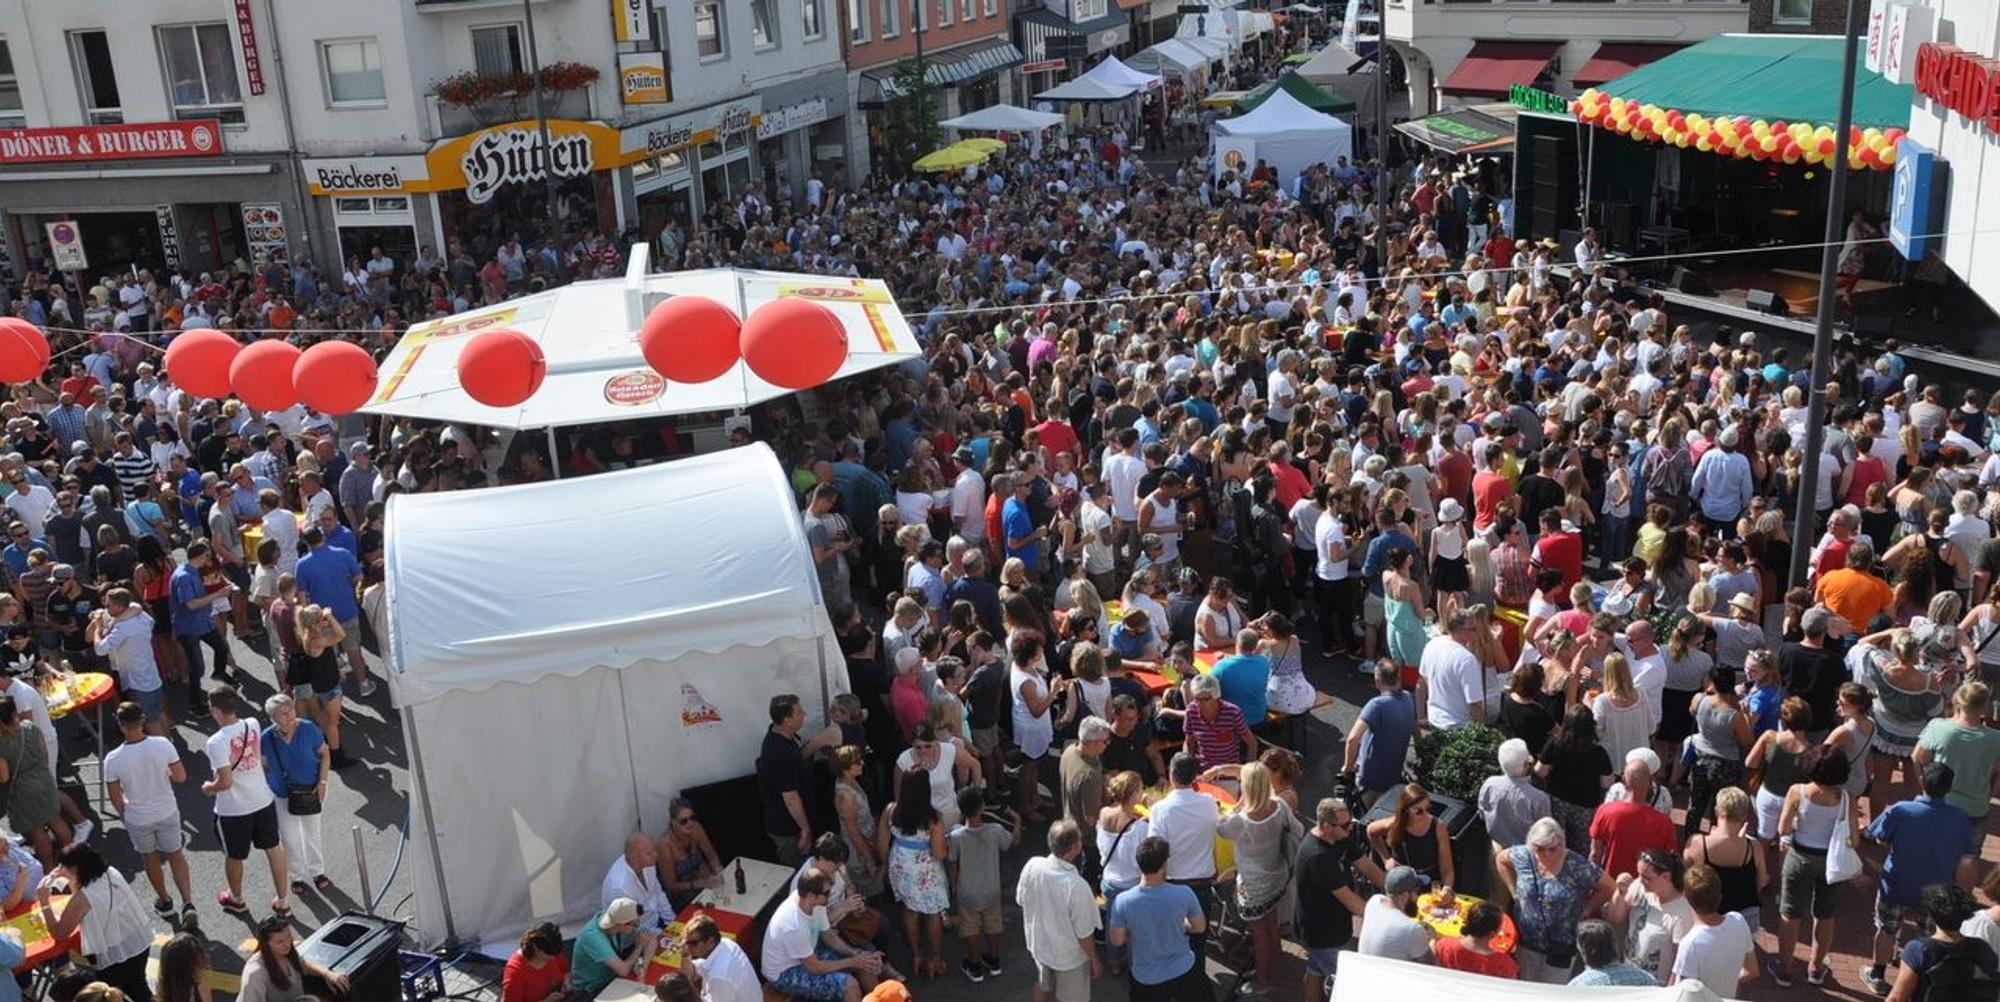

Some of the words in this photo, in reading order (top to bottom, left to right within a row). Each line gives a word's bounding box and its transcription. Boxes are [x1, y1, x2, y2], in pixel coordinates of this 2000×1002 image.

[241, 23, 263, 94] BURGER
[626, 73, 663, 93] Hütten
[0, 131, 72, 157] DÖNER
[77, 134, 93, 154] &
[96, 129, 187, 153] BURGER
[647, 120, 693, 152] Bäckerei
[317, 165, 401, 191] Bäckerei
[466, 132, 590, 195] Hüten
